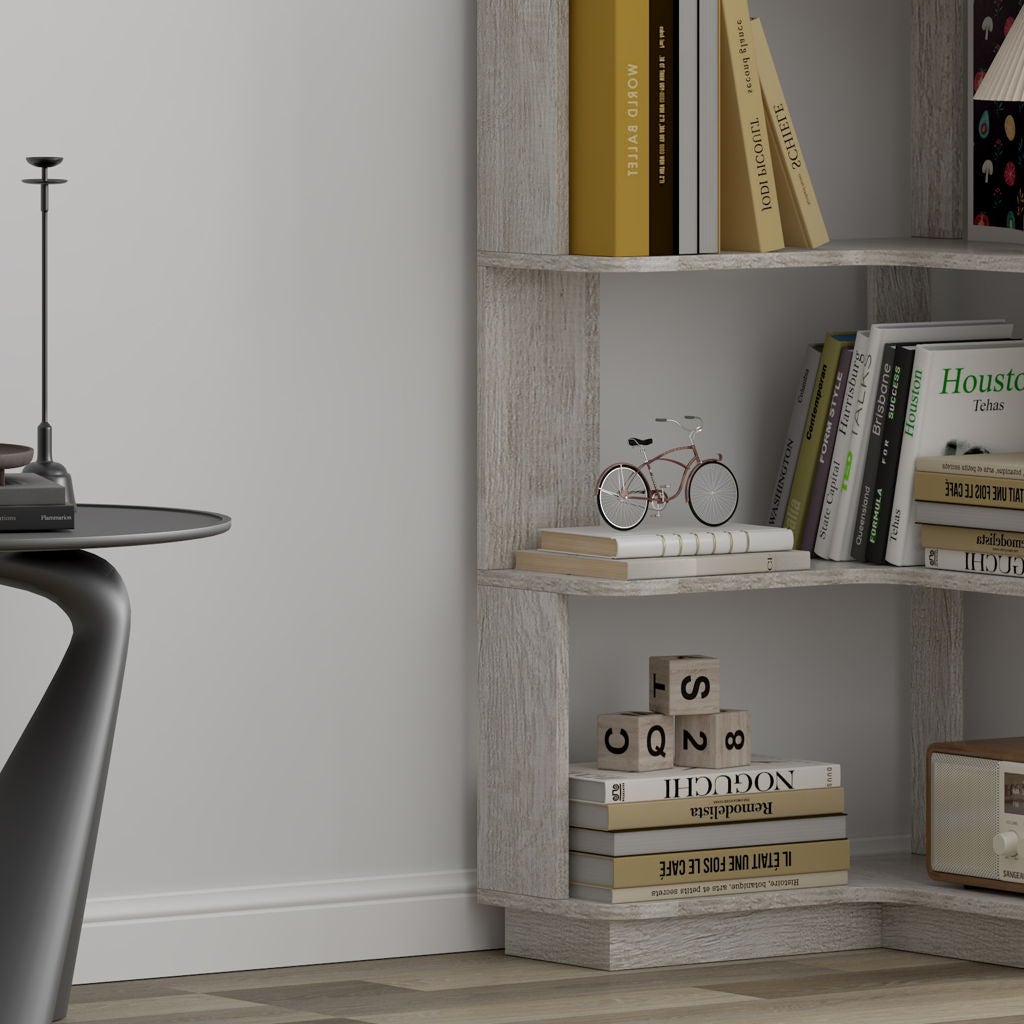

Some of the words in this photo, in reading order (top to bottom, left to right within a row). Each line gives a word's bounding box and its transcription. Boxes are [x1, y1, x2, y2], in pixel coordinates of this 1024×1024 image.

[806, 364, 828, 440] Contemporan
[852, 354, 872, 436] TALKS
[972, 399, 1005, 412] Tehas
[819, 422, 832, 464] FORM
[830, 372, 843, 418] STYLE
[820, 508, 831, 540] State
[827, 460, 840, 504] Capital
[839, 352, 864, 436] Harrisburg
[856, 485, 871, 546] Queensland
[872, 363, 891, 436] Brisbane
[870, 488, 882, 544] FORMULA
[888, 365, 901, 420] SUCCESS
[890, 508, 901, 541] Tehas
[904, 370, 923, 438] Houston
[769, 438, 794, 526] WASHINGTON
[653, 673, 665, 698] T
[681, 675, 710, 700] S
[604, 727, 630, 755] C
[646, 725, 666, 758] Q
[683, 730, 708, 751] 2
[724, 730, 745, 751] 8
[664, 770, 794, 799] NOGUCHI
[690, 801, 773, 820] Remodelista
[688, 858, 701, 875] LE
[704, 856, 726, 873] FOIS
[728, 854, 748, 871] UNE
[752, 852, 780, 871] ÉTAIT
[782, 851, 792, 867] IL
[660, 860, 686, 880] CAFÉ
[651, 888, 678, 898] secrets
[680, 884, 700, 896] petits
[712, 884, 727, 892] arts
[729, 880, 766, 892] botanique,
[768, 878, 799, 888] Histoire,
